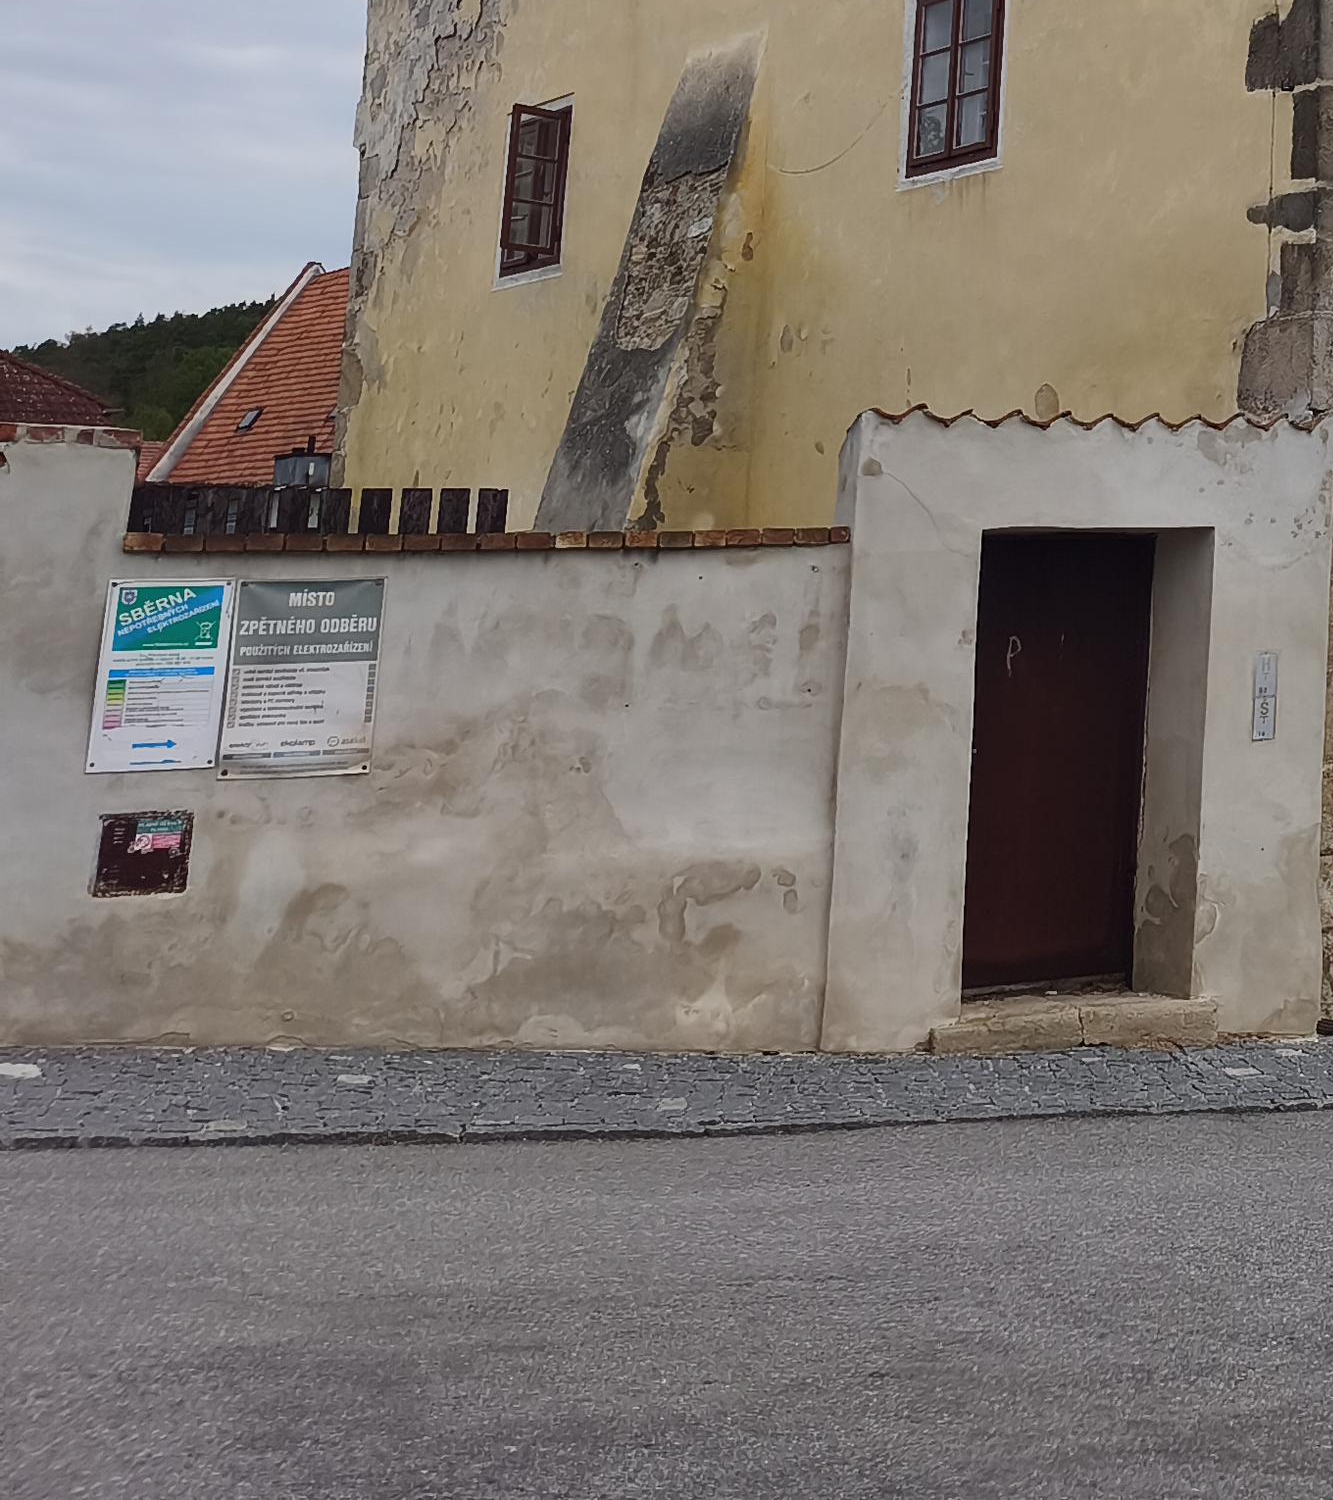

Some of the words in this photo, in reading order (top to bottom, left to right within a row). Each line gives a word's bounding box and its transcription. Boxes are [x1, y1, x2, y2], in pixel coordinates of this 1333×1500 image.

[119, 588, 197, 626] SBĚRNA
[288, 589, 335, 607] MÍSTO
[240, 616, 316, 635] ZPĚTNÉHO
[320, 614, 377, 633] ODBĚRU
[240, 643, 290, 656] POUŽITÝCH
[293, 640, 373, 655] ELEKTROZAŘÍZENÍ
